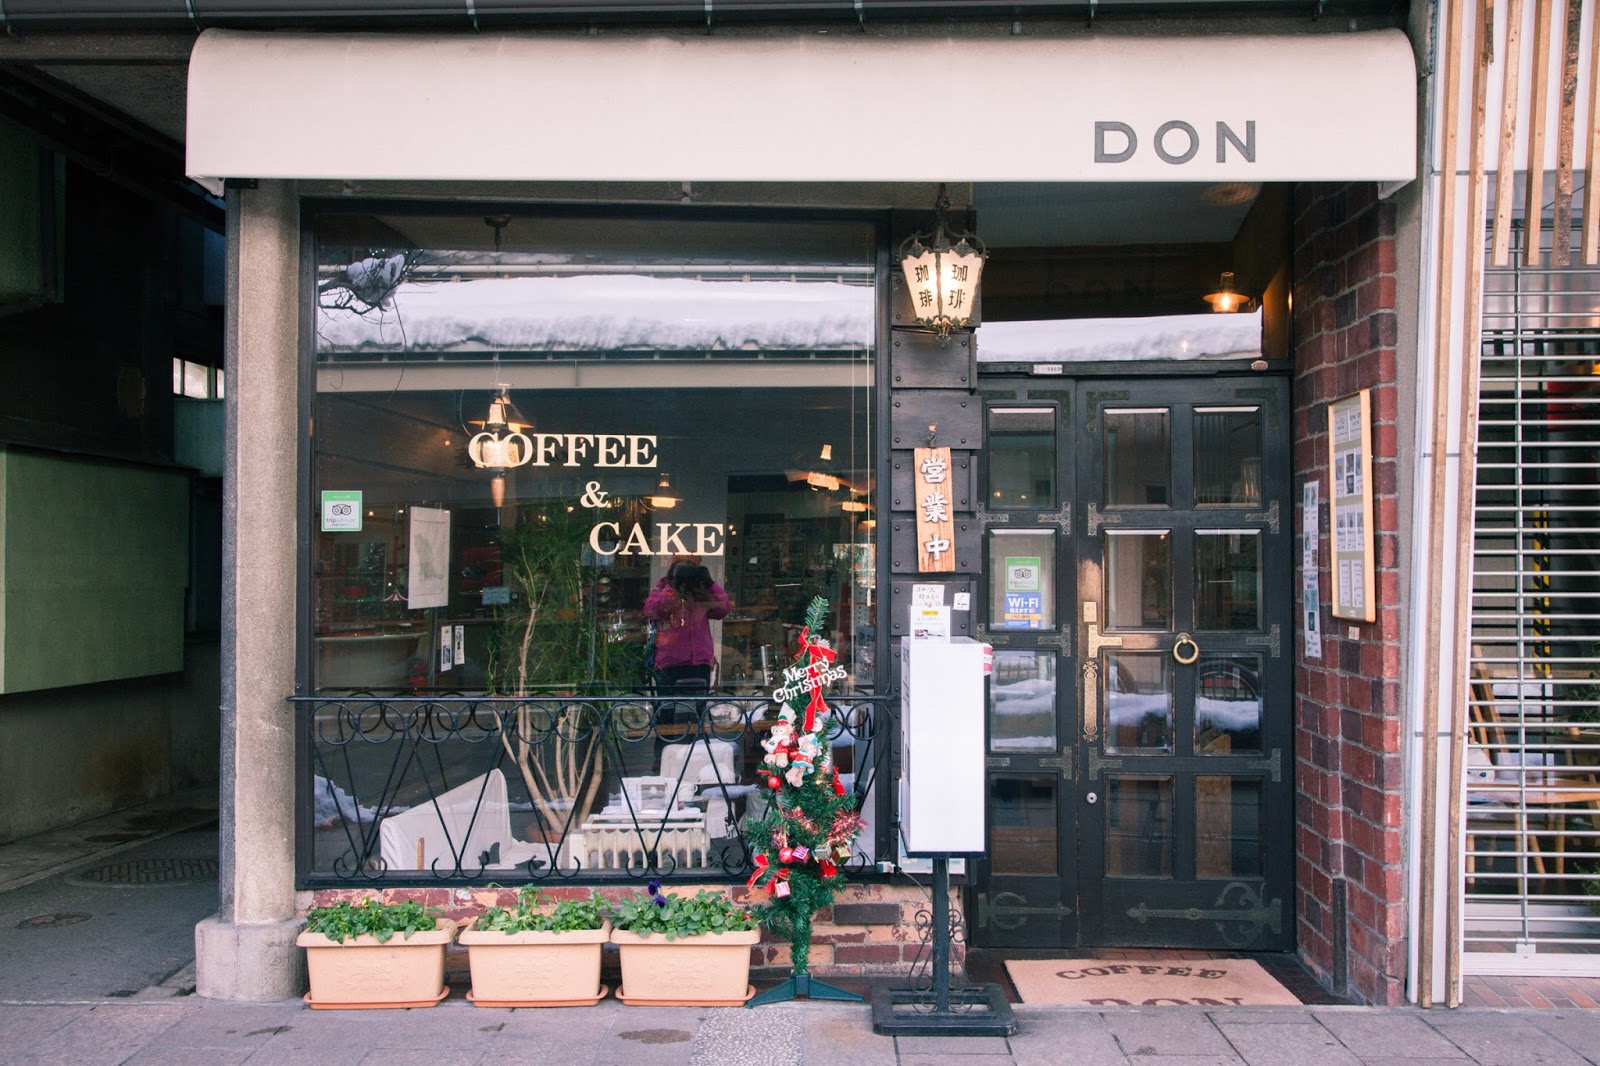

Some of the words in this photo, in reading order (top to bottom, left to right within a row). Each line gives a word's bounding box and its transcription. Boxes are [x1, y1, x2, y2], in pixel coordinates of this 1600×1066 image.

[1094, 120, 1256, 165] DON
[914, 264, 933, 308] 珈琲
[468, 432, 658, 469] COFFEE
[580, 480, 609, 508] &
[920, 456, 951, 561] 営業中
[589, 522, 725, 557] CAKE
[1008, 597, 1039, 608] Wi-Fi
[772, 664, 848, 703] Christmas
[782, 657, 829, 687] Merry
[1056, 965, 1227, 980] COFFEE
